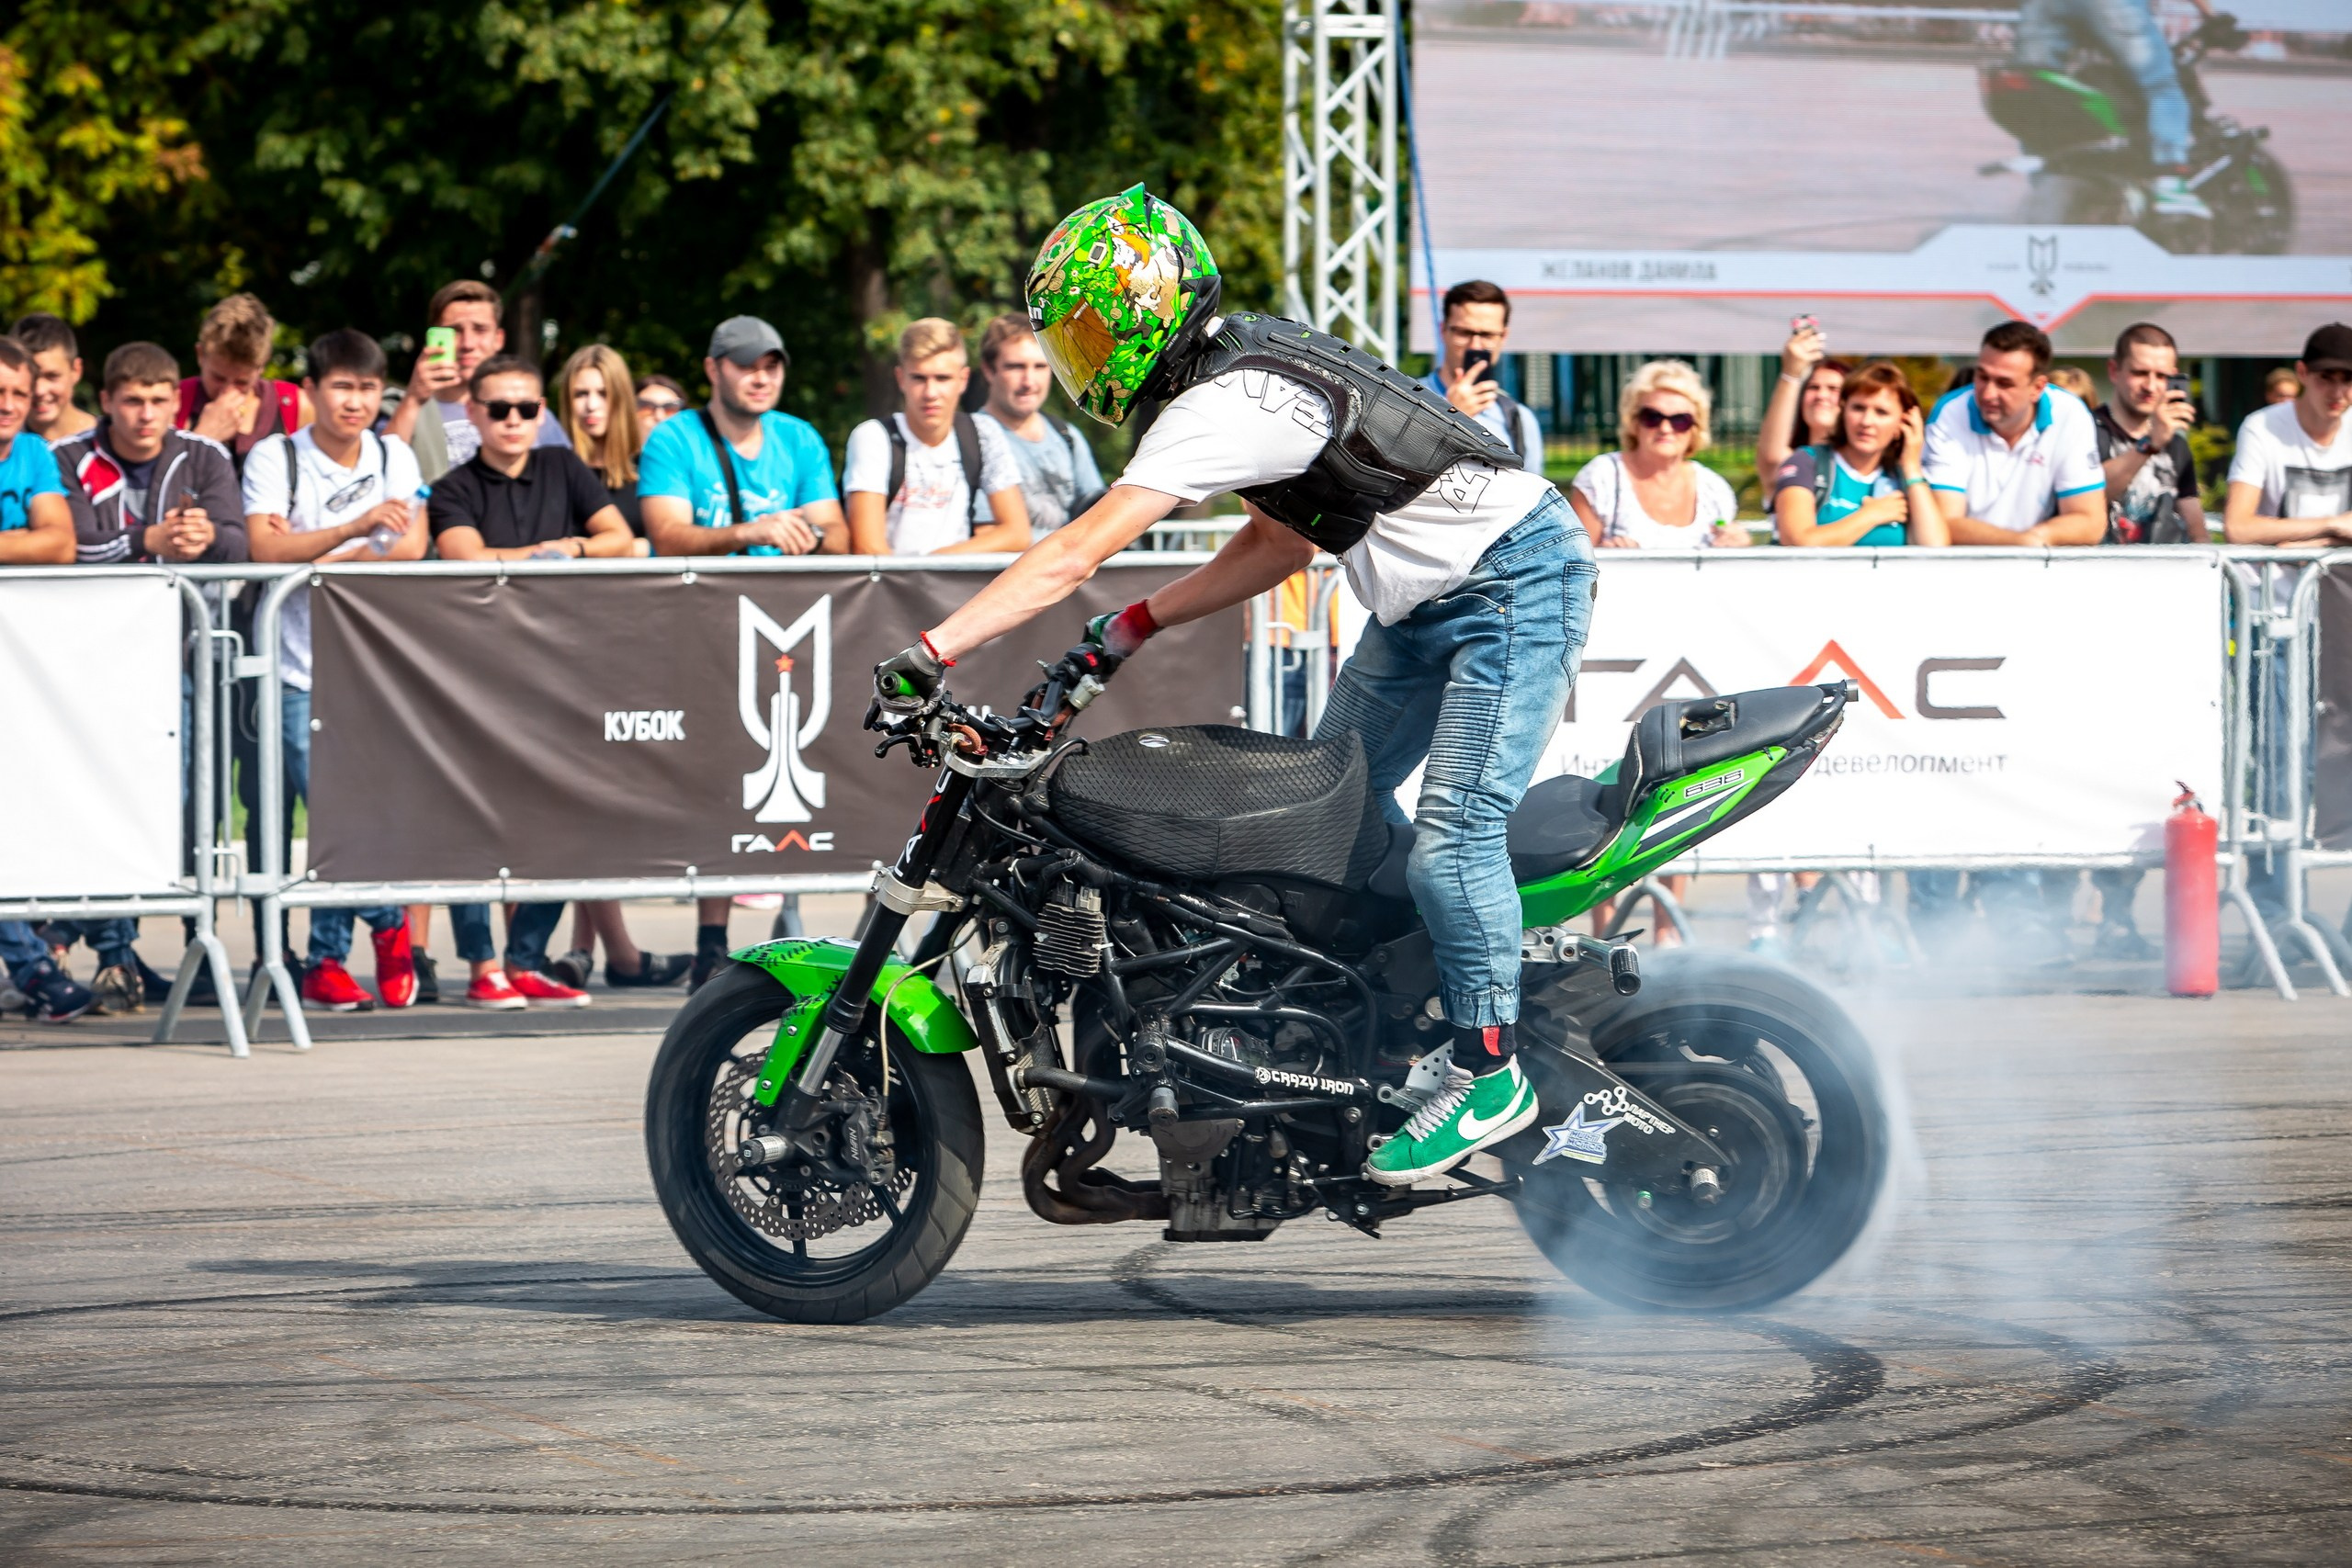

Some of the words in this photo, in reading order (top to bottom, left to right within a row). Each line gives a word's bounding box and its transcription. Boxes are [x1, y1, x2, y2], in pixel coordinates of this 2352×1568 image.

[604, 710, 686, 741] КУБОК
[1814, 753, 2007, 777] девелопмент
[1685, 770, 1743, 797] 636
[730, 829, 834, 853] ГАЛС
[1272, 1070, 1317, 1090] CRAZY
[1320, 1078, 1354, 1095] IRON
[1623, 1111, 1654, 1134] МОТО
[1628, 1103, 1676, 1134] ПАРТНЕР
[1566, 1138, 1606, 1152] MOTOR
